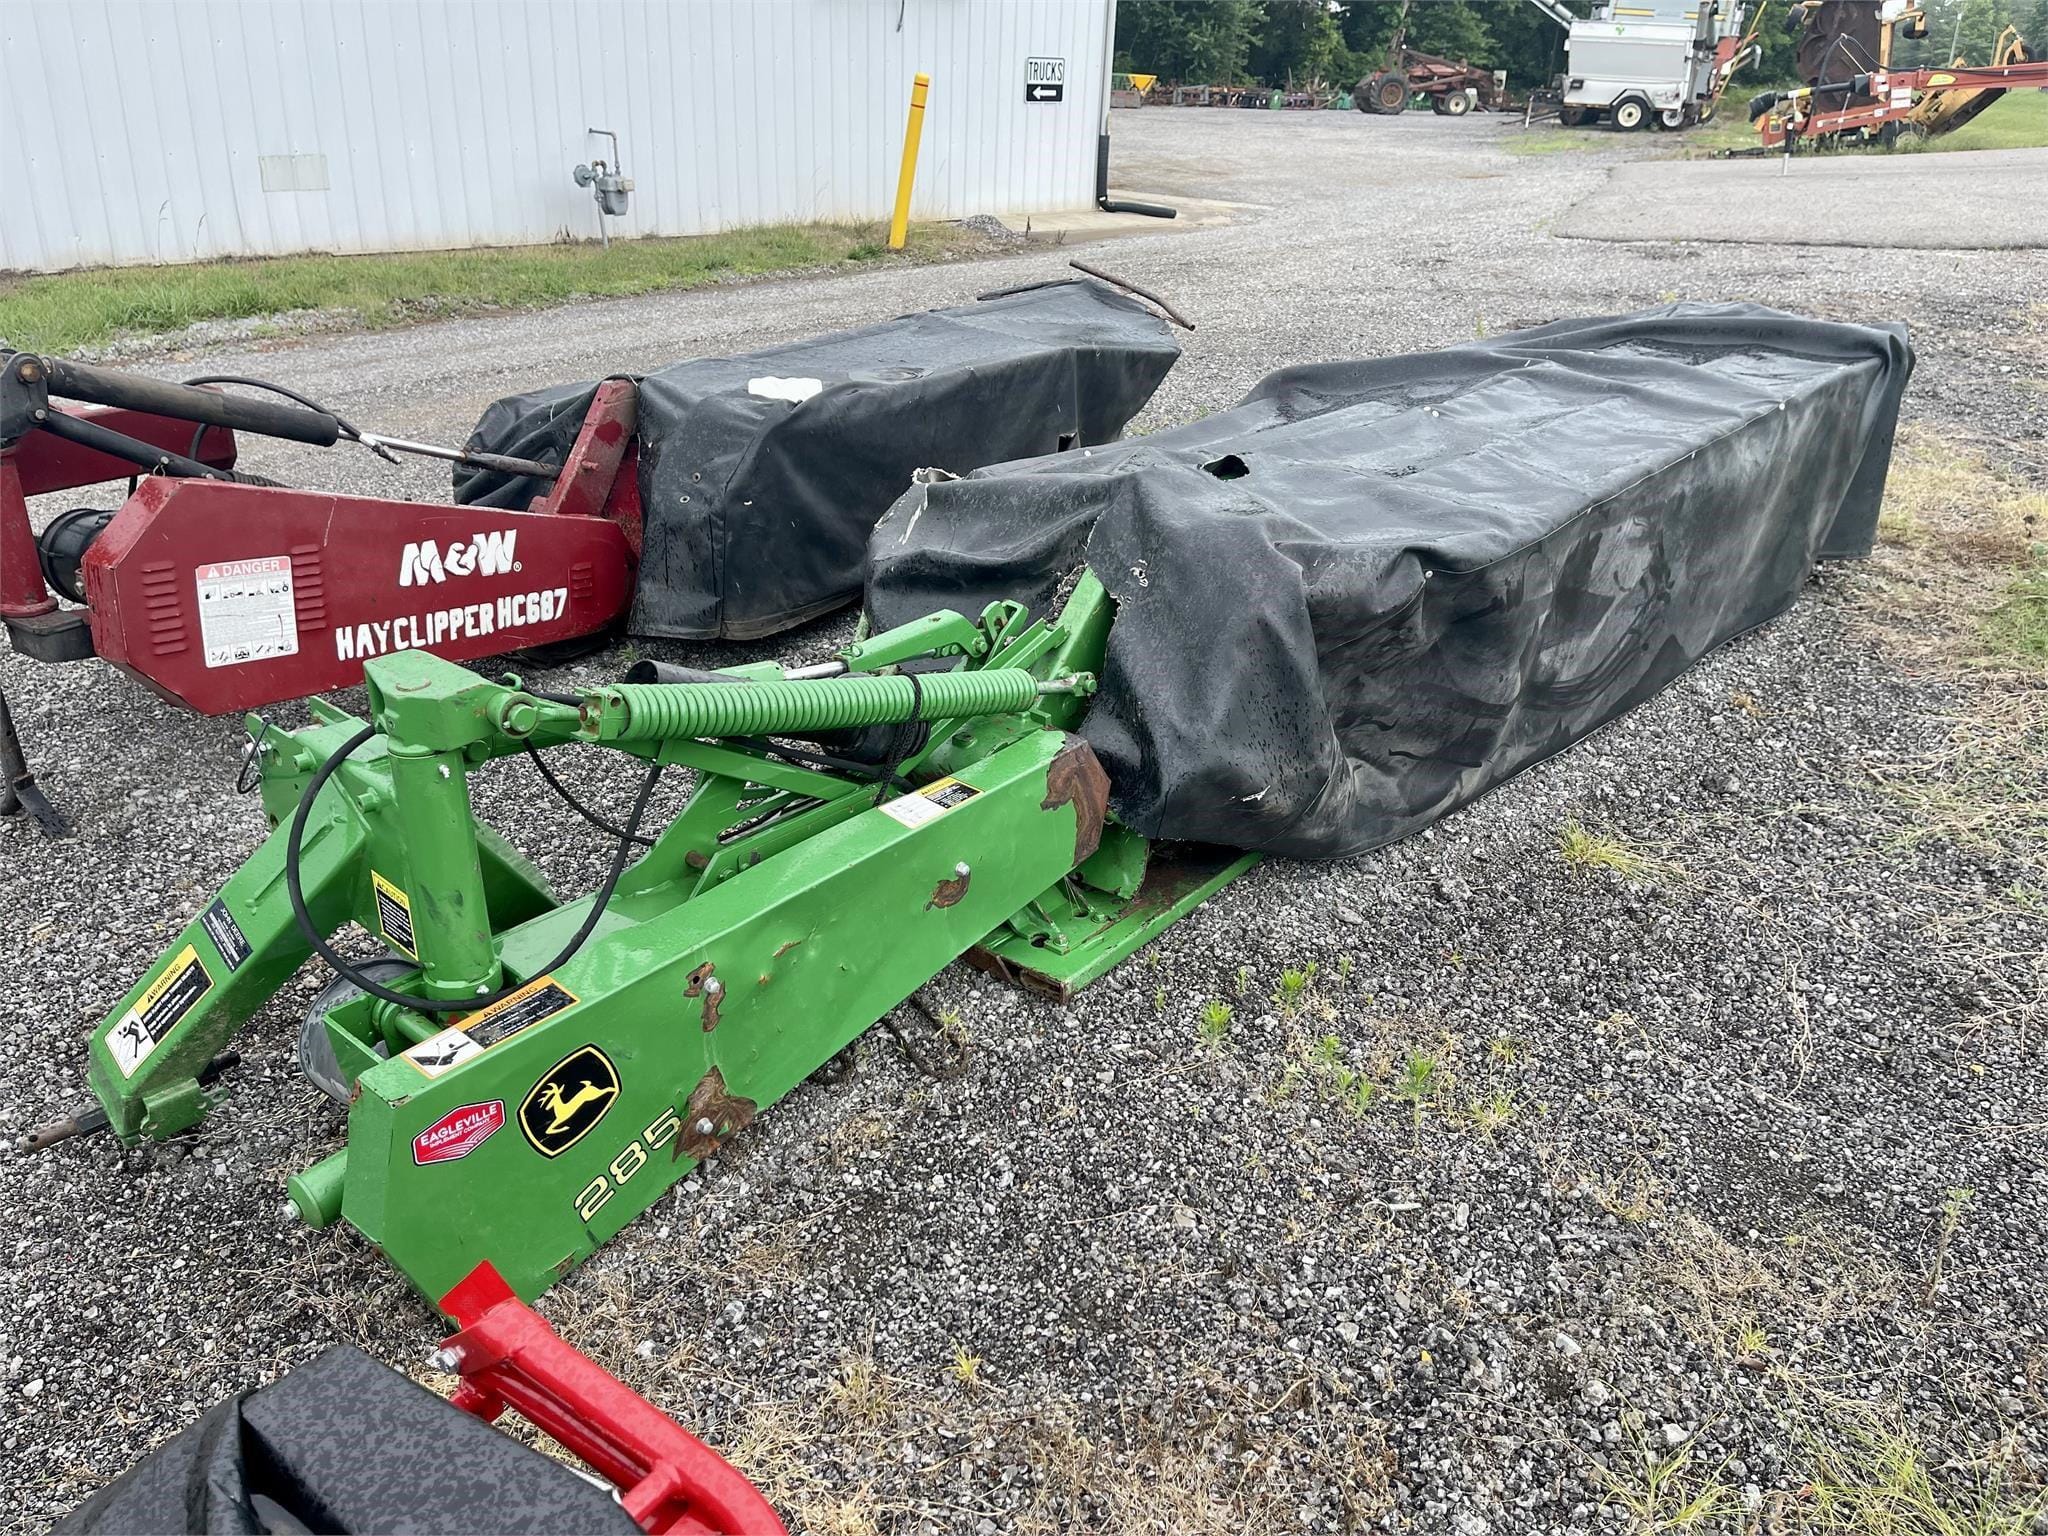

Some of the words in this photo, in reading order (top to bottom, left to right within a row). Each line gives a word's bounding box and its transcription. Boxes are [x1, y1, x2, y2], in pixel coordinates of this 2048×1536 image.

[1028, 61, 1063, 81] TRUCKS
[222, 559, 280, 577] DANGER
[497, 587, 568, 630] HC687
[151, 963, 182, 998] WARNING
[486, 986, 538, 1014] WARNING
[420, 1104, 497, 1147] EAGLEVILLE
[429, 1129, 463, 1148] IMPLEMENT
[463, 1116, 491, 1135] COMPANY
[573, 1105, 681, 1225] 285
